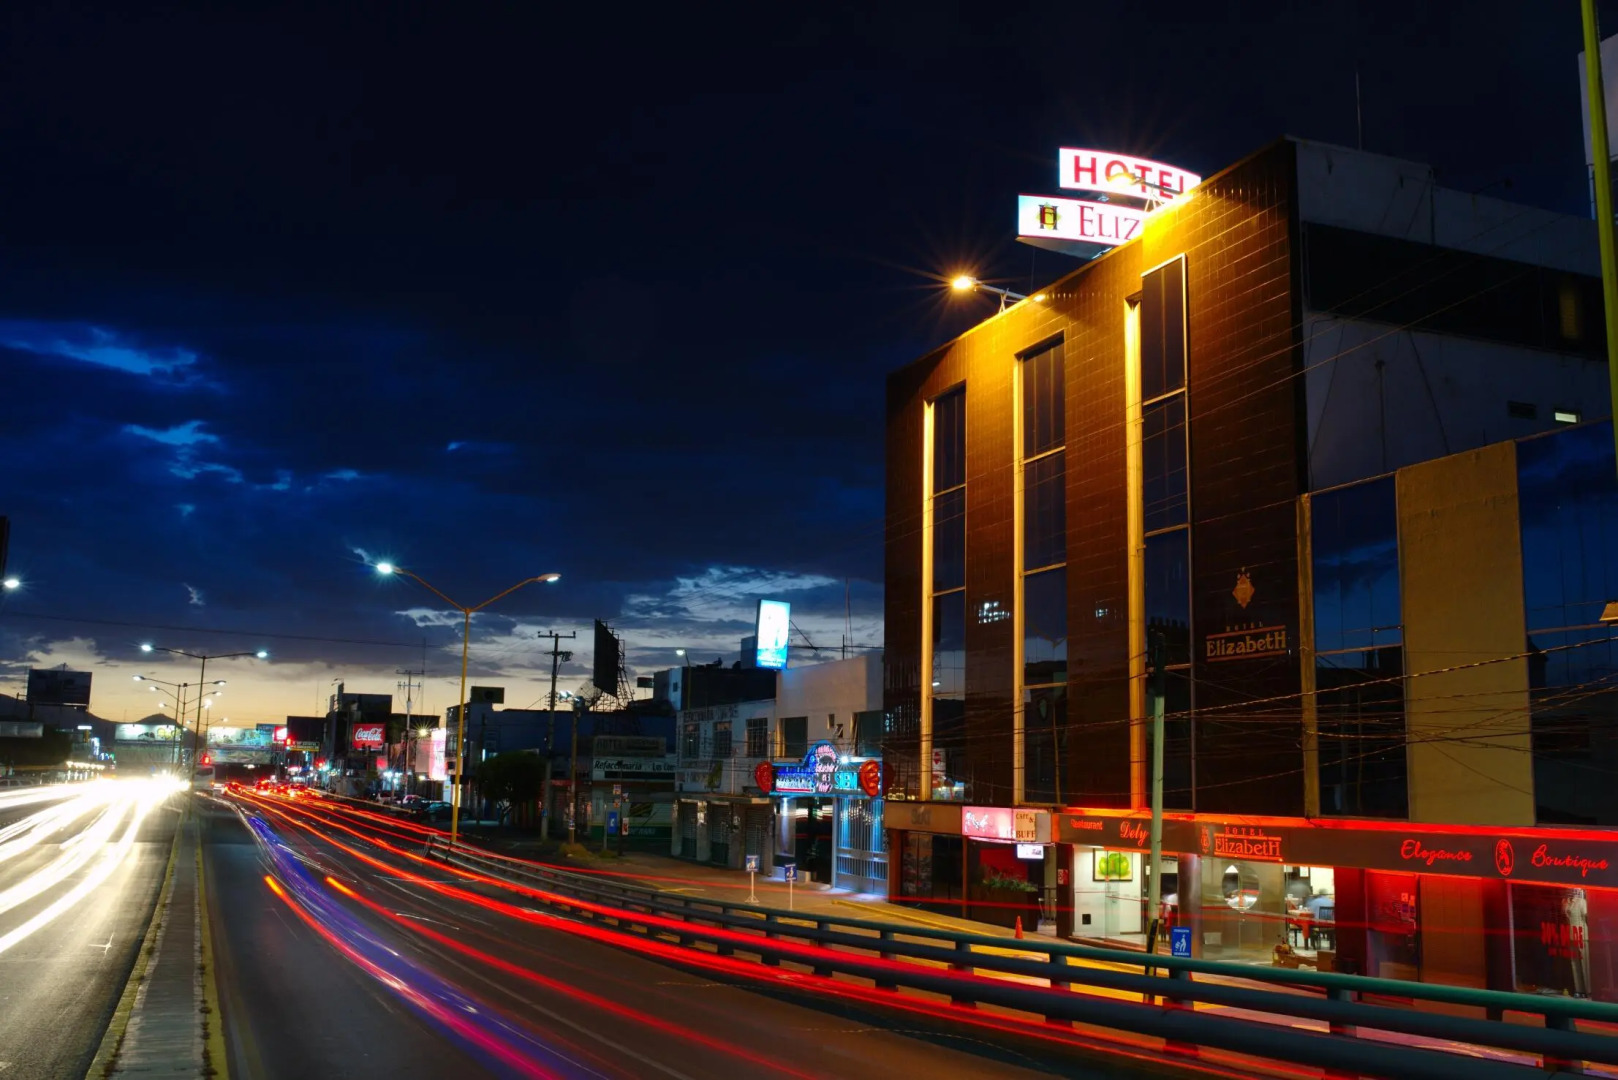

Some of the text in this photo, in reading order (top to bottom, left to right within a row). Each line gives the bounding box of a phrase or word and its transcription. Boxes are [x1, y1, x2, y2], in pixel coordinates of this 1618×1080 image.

[1119, 819, 1149, 847] Dely
[1225, 827, 1264, 837] HOTEL
[1401, 840, 1608, 877] Elegance Boutique
